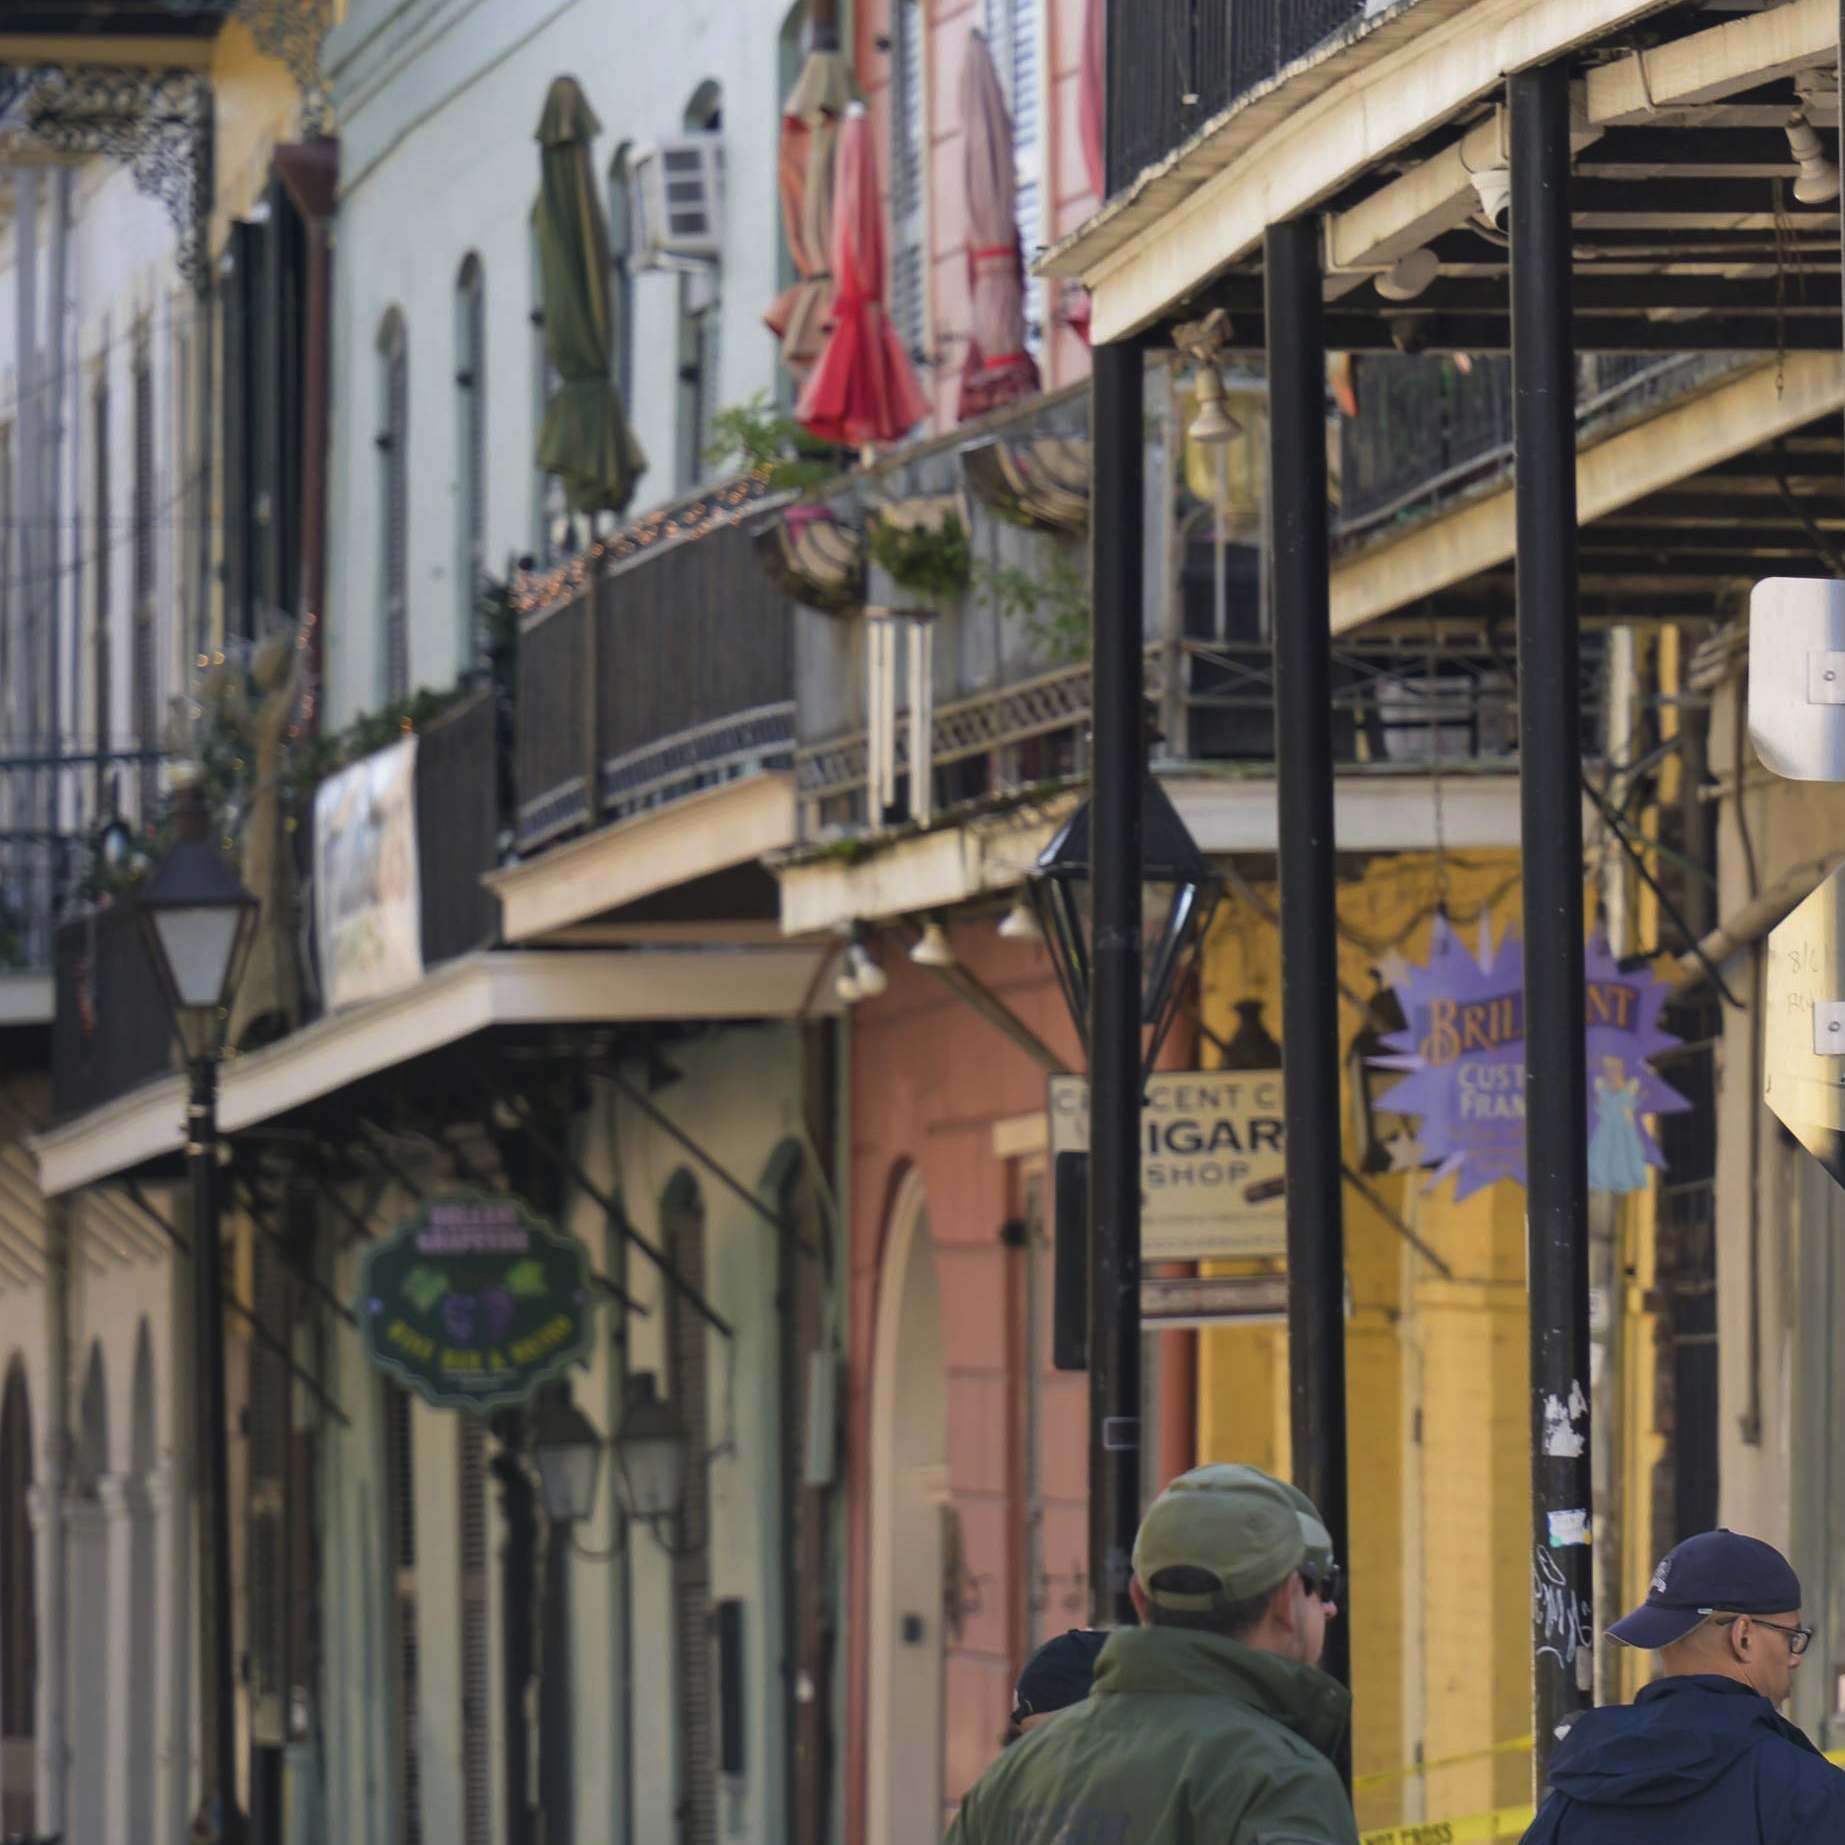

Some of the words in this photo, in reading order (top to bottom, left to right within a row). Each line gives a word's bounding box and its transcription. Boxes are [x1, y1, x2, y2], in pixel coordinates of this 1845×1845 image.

[1419, 982, 1637, 1067] BRILNT
[1458, 1062, 1525, 1087] CUST
[1148, 1117, 1284, 1155] IGAR
[1147, 1160, 1249, 1188] SHOP
